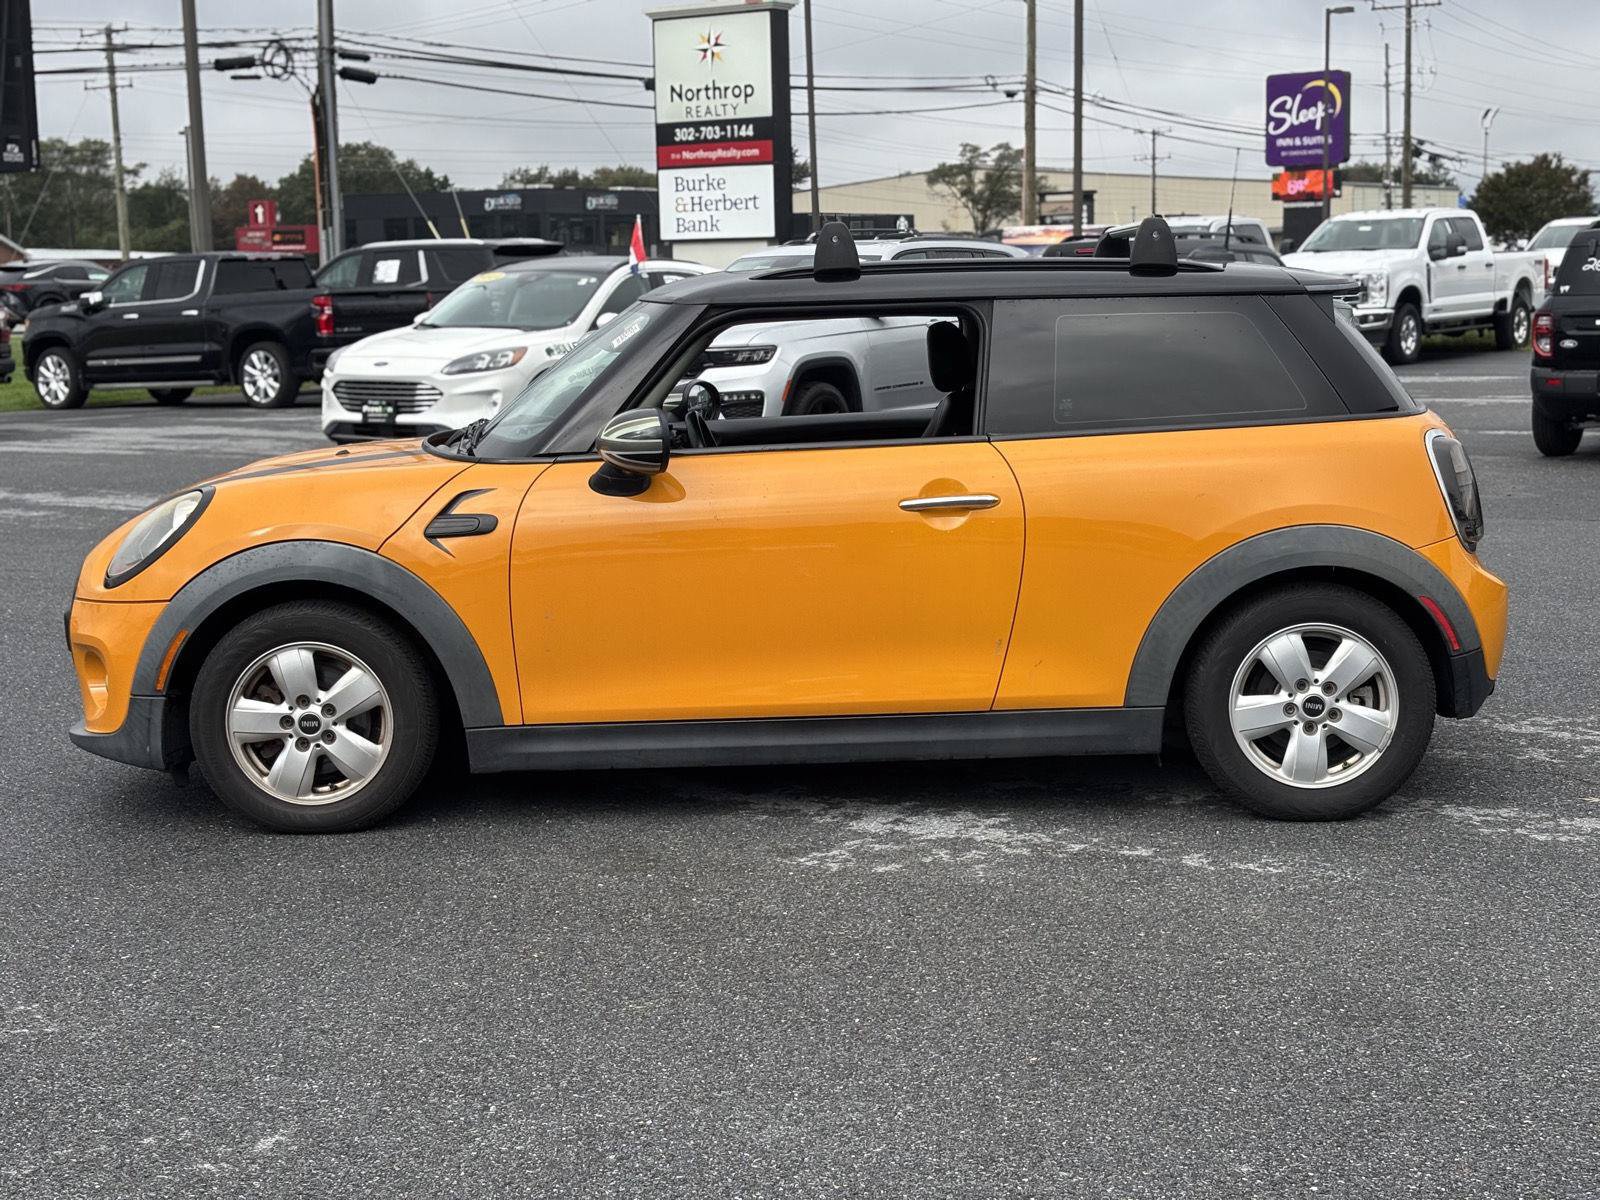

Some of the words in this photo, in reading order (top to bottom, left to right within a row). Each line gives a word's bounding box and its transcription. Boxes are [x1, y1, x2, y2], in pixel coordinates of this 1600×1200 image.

[670, 79, 755, 104] Northrop
[685, 104, 739, 118] REALTY
[674, 124, 754, 141] 302-703-1144
[674, 173, 727, 192] Burke
[676, 214, 721, 233] Bank
[1305, 702, 1322, 710] MINI
